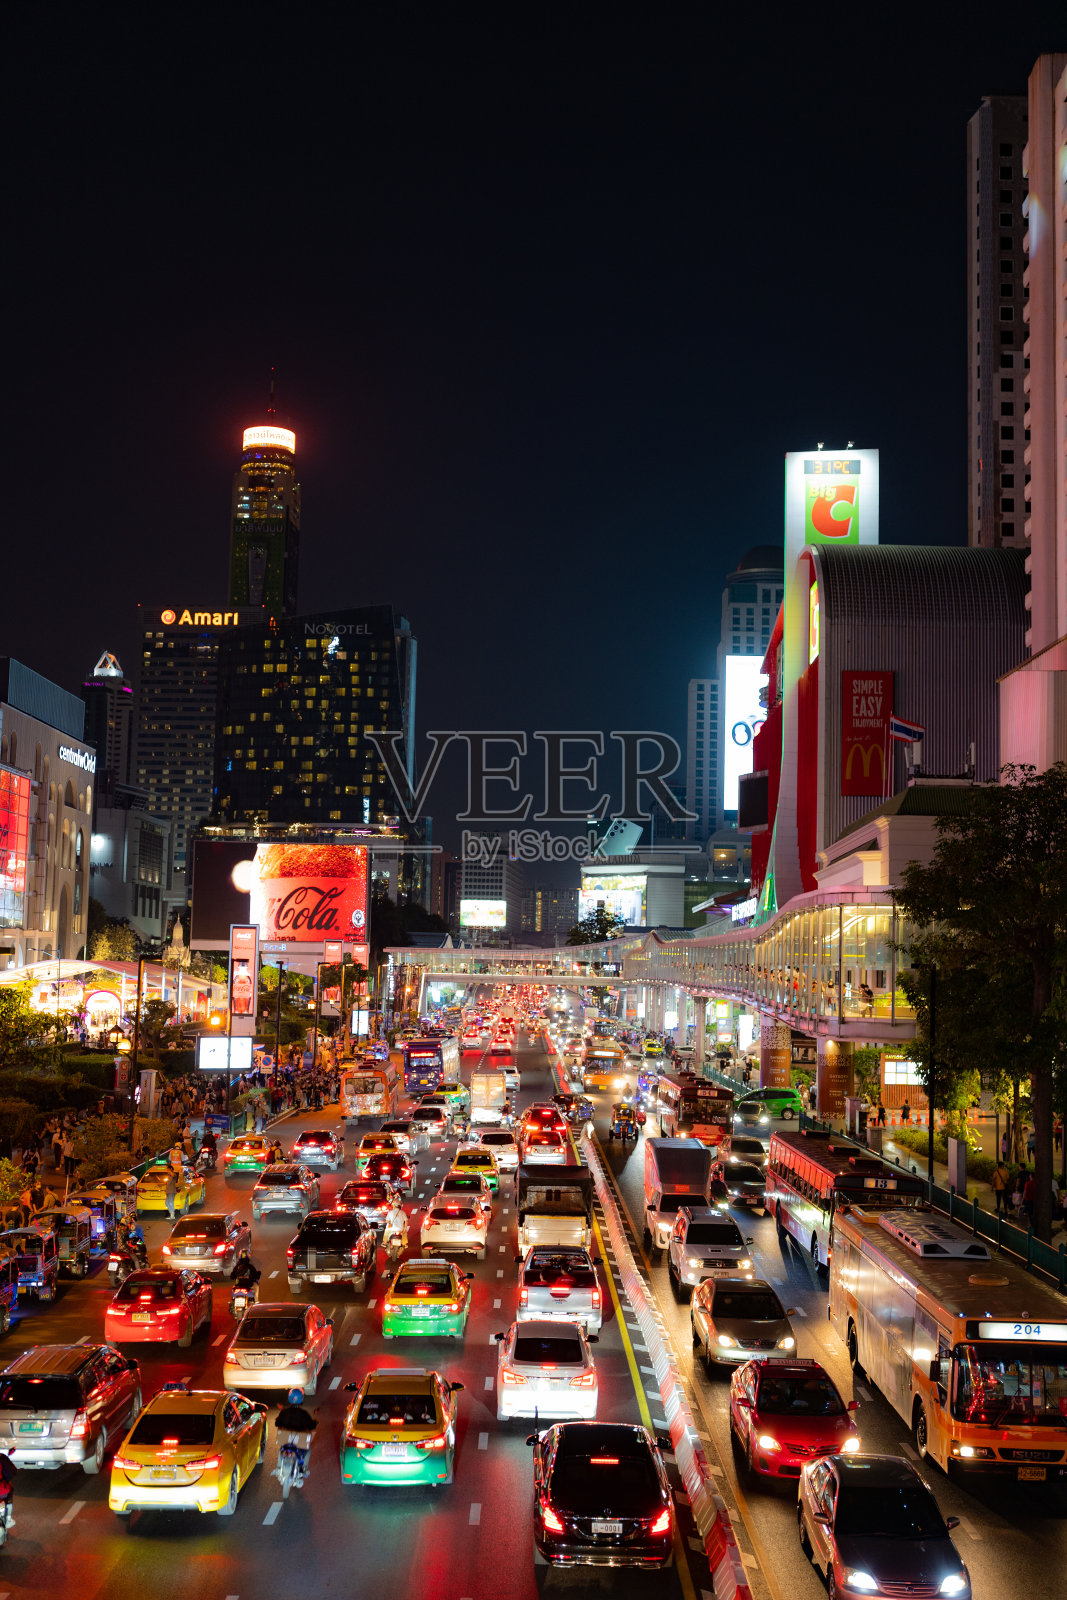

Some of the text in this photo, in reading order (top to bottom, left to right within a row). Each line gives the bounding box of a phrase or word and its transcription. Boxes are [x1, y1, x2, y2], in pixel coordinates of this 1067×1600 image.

[808, 484, 837, 501] Big
[178, 609, 239, 626] Amari
[304, 623, 373, 635] NOVOTEL
[853, 679, 883, 694] SIMPLE
[853, 696, 883, 717] EASY
[853, 718, 883, 729] ENJOYMENT
[874, 1179, 888, 1189] 13
[1013, 1324, 1042, 1336] 204
[1012, 1450, 1051, 1460] ISUZU
